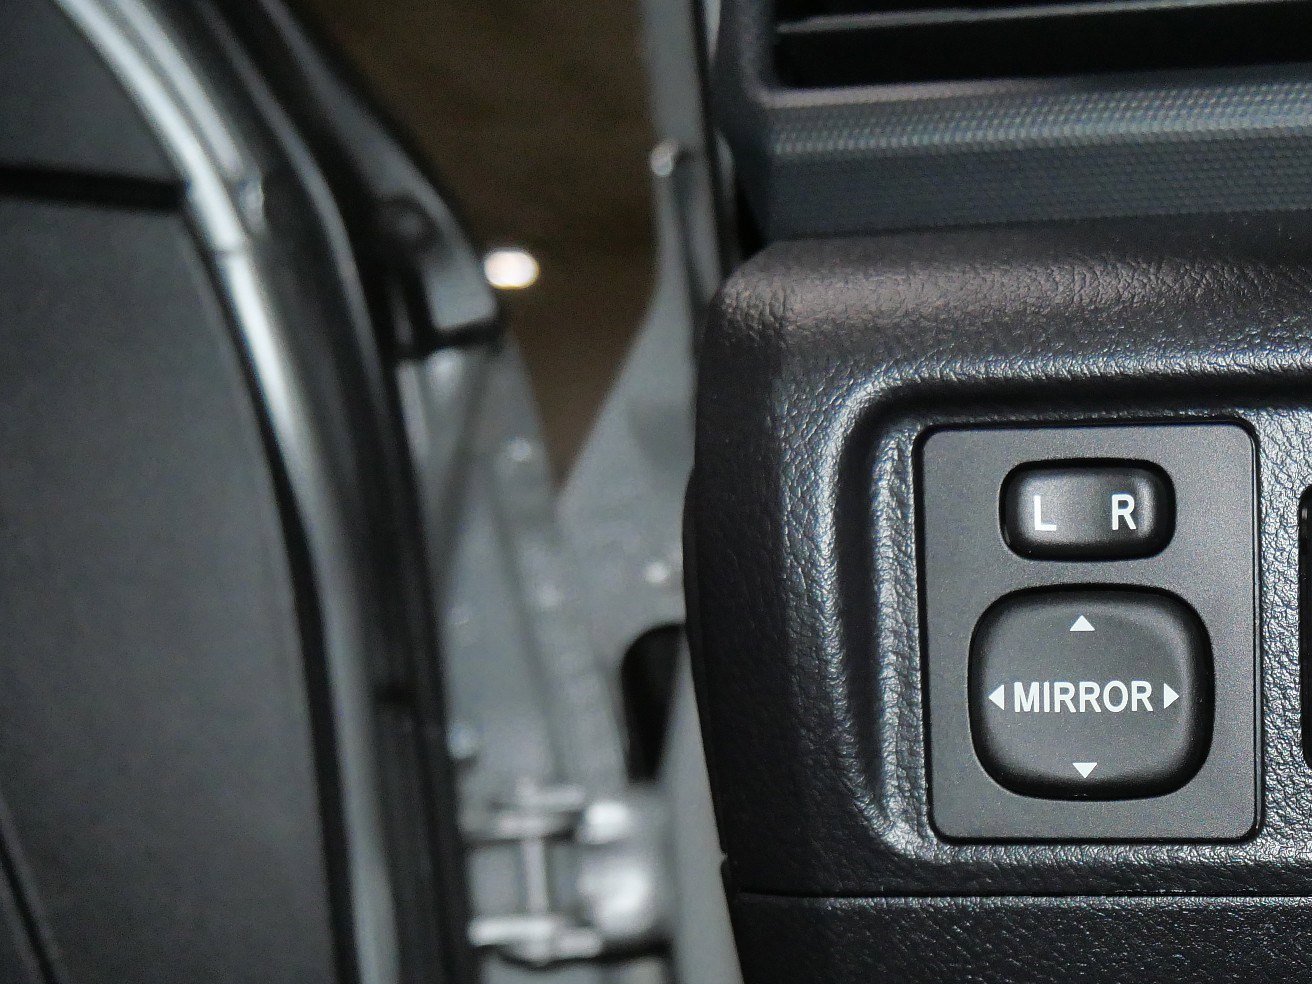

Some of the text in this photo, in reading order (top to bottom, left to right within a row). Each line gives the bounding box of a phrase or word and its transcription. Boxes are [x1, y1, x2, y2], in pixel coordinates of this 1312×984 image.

[1034, 494, 1137, 531] L R
[1014, 680, 1154, 713] MIRROR
